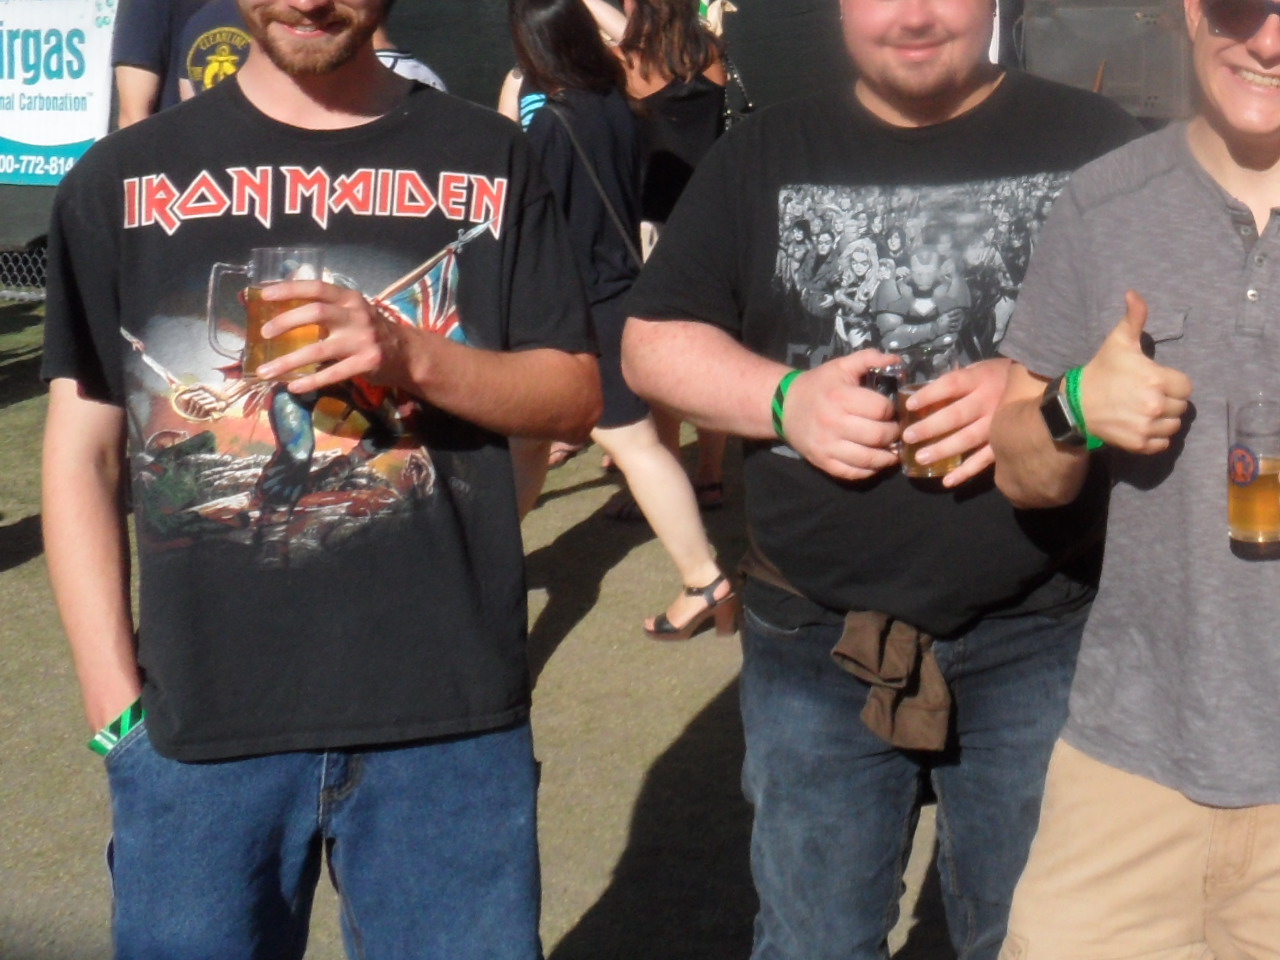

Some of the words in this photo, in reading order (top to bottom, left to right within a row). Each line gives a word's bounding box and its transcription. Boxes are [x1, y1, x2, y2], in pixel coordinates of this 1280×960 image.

[19, 92, 88, 112] Carbonation
[124, 166, 272, 236] IRON
[280, 166, 508, 240] MAIDEN
